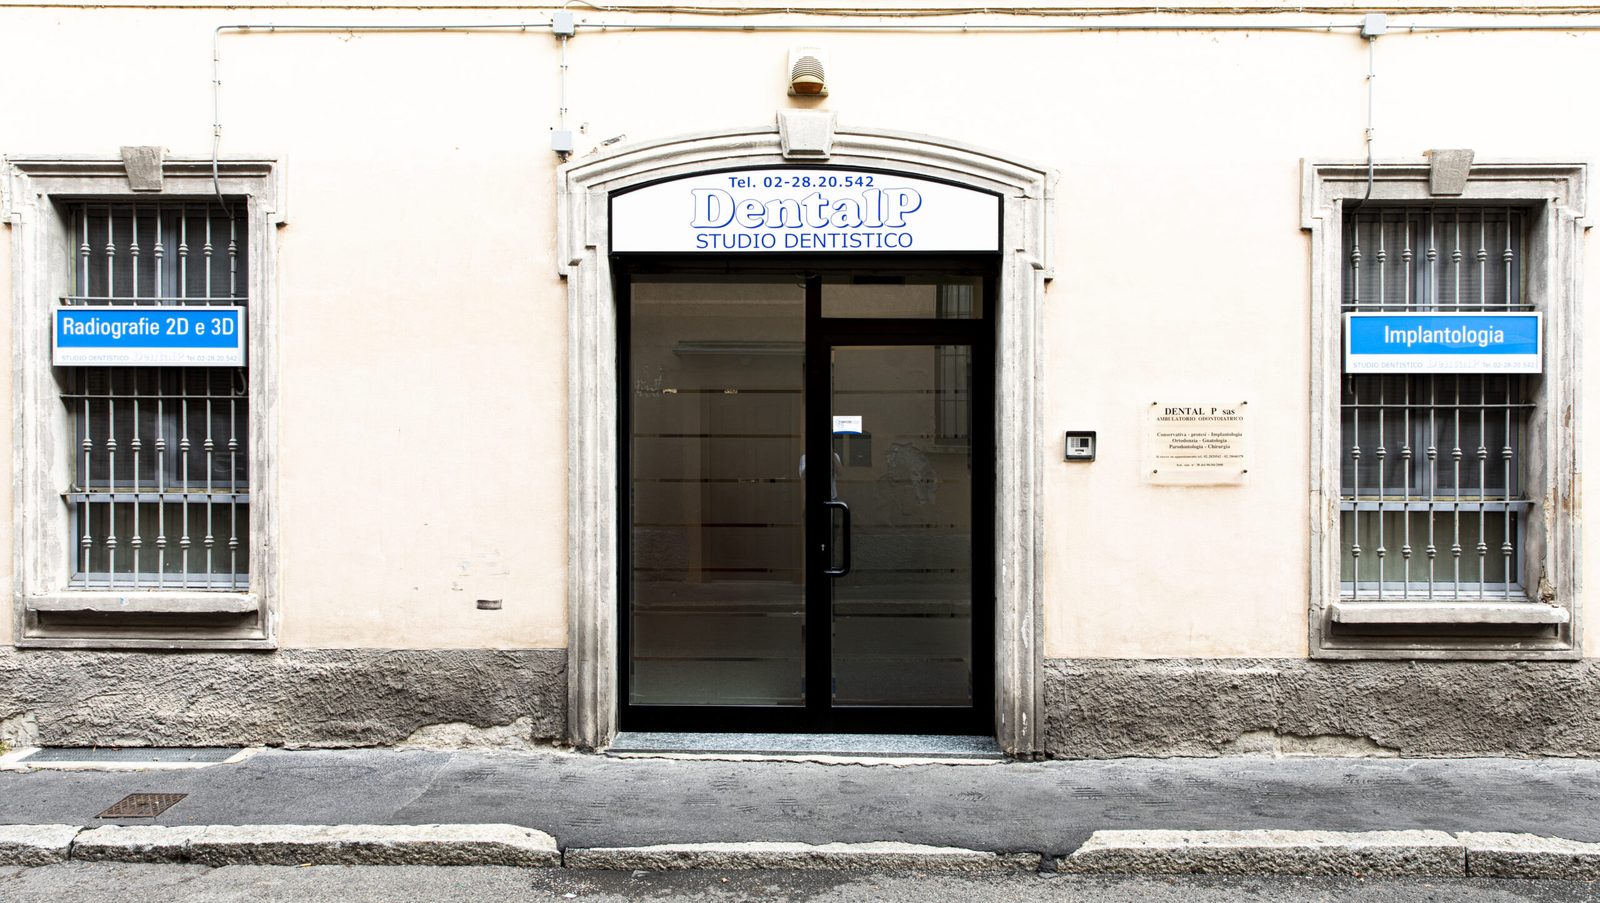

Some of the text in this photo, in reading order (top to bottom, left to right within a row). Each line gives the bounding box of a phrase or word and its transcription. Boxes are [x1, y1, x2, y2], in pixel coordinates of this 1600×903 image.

[728, 176, 875, 188] Tel. 02-28.20.542
[690, 187, 923, 230] DentalP
[696, 232, 914, 249] STUDIO DENTISTICO
[63, 317, 234, 339] Radiografie 2D e 3D
[1384, 325, 1505, 348] Implantologia
[61, 354, 87, 362] STUDIO
[88, 354, 129, 362] DENTISTICO
[1353, 361, 1379, 369] STUDIO
[1381, 361, 1424, 369] DENTISTICO
[1164, 407, 1206, 416] DENTAL
[1211, 407, 1218, 416] P
